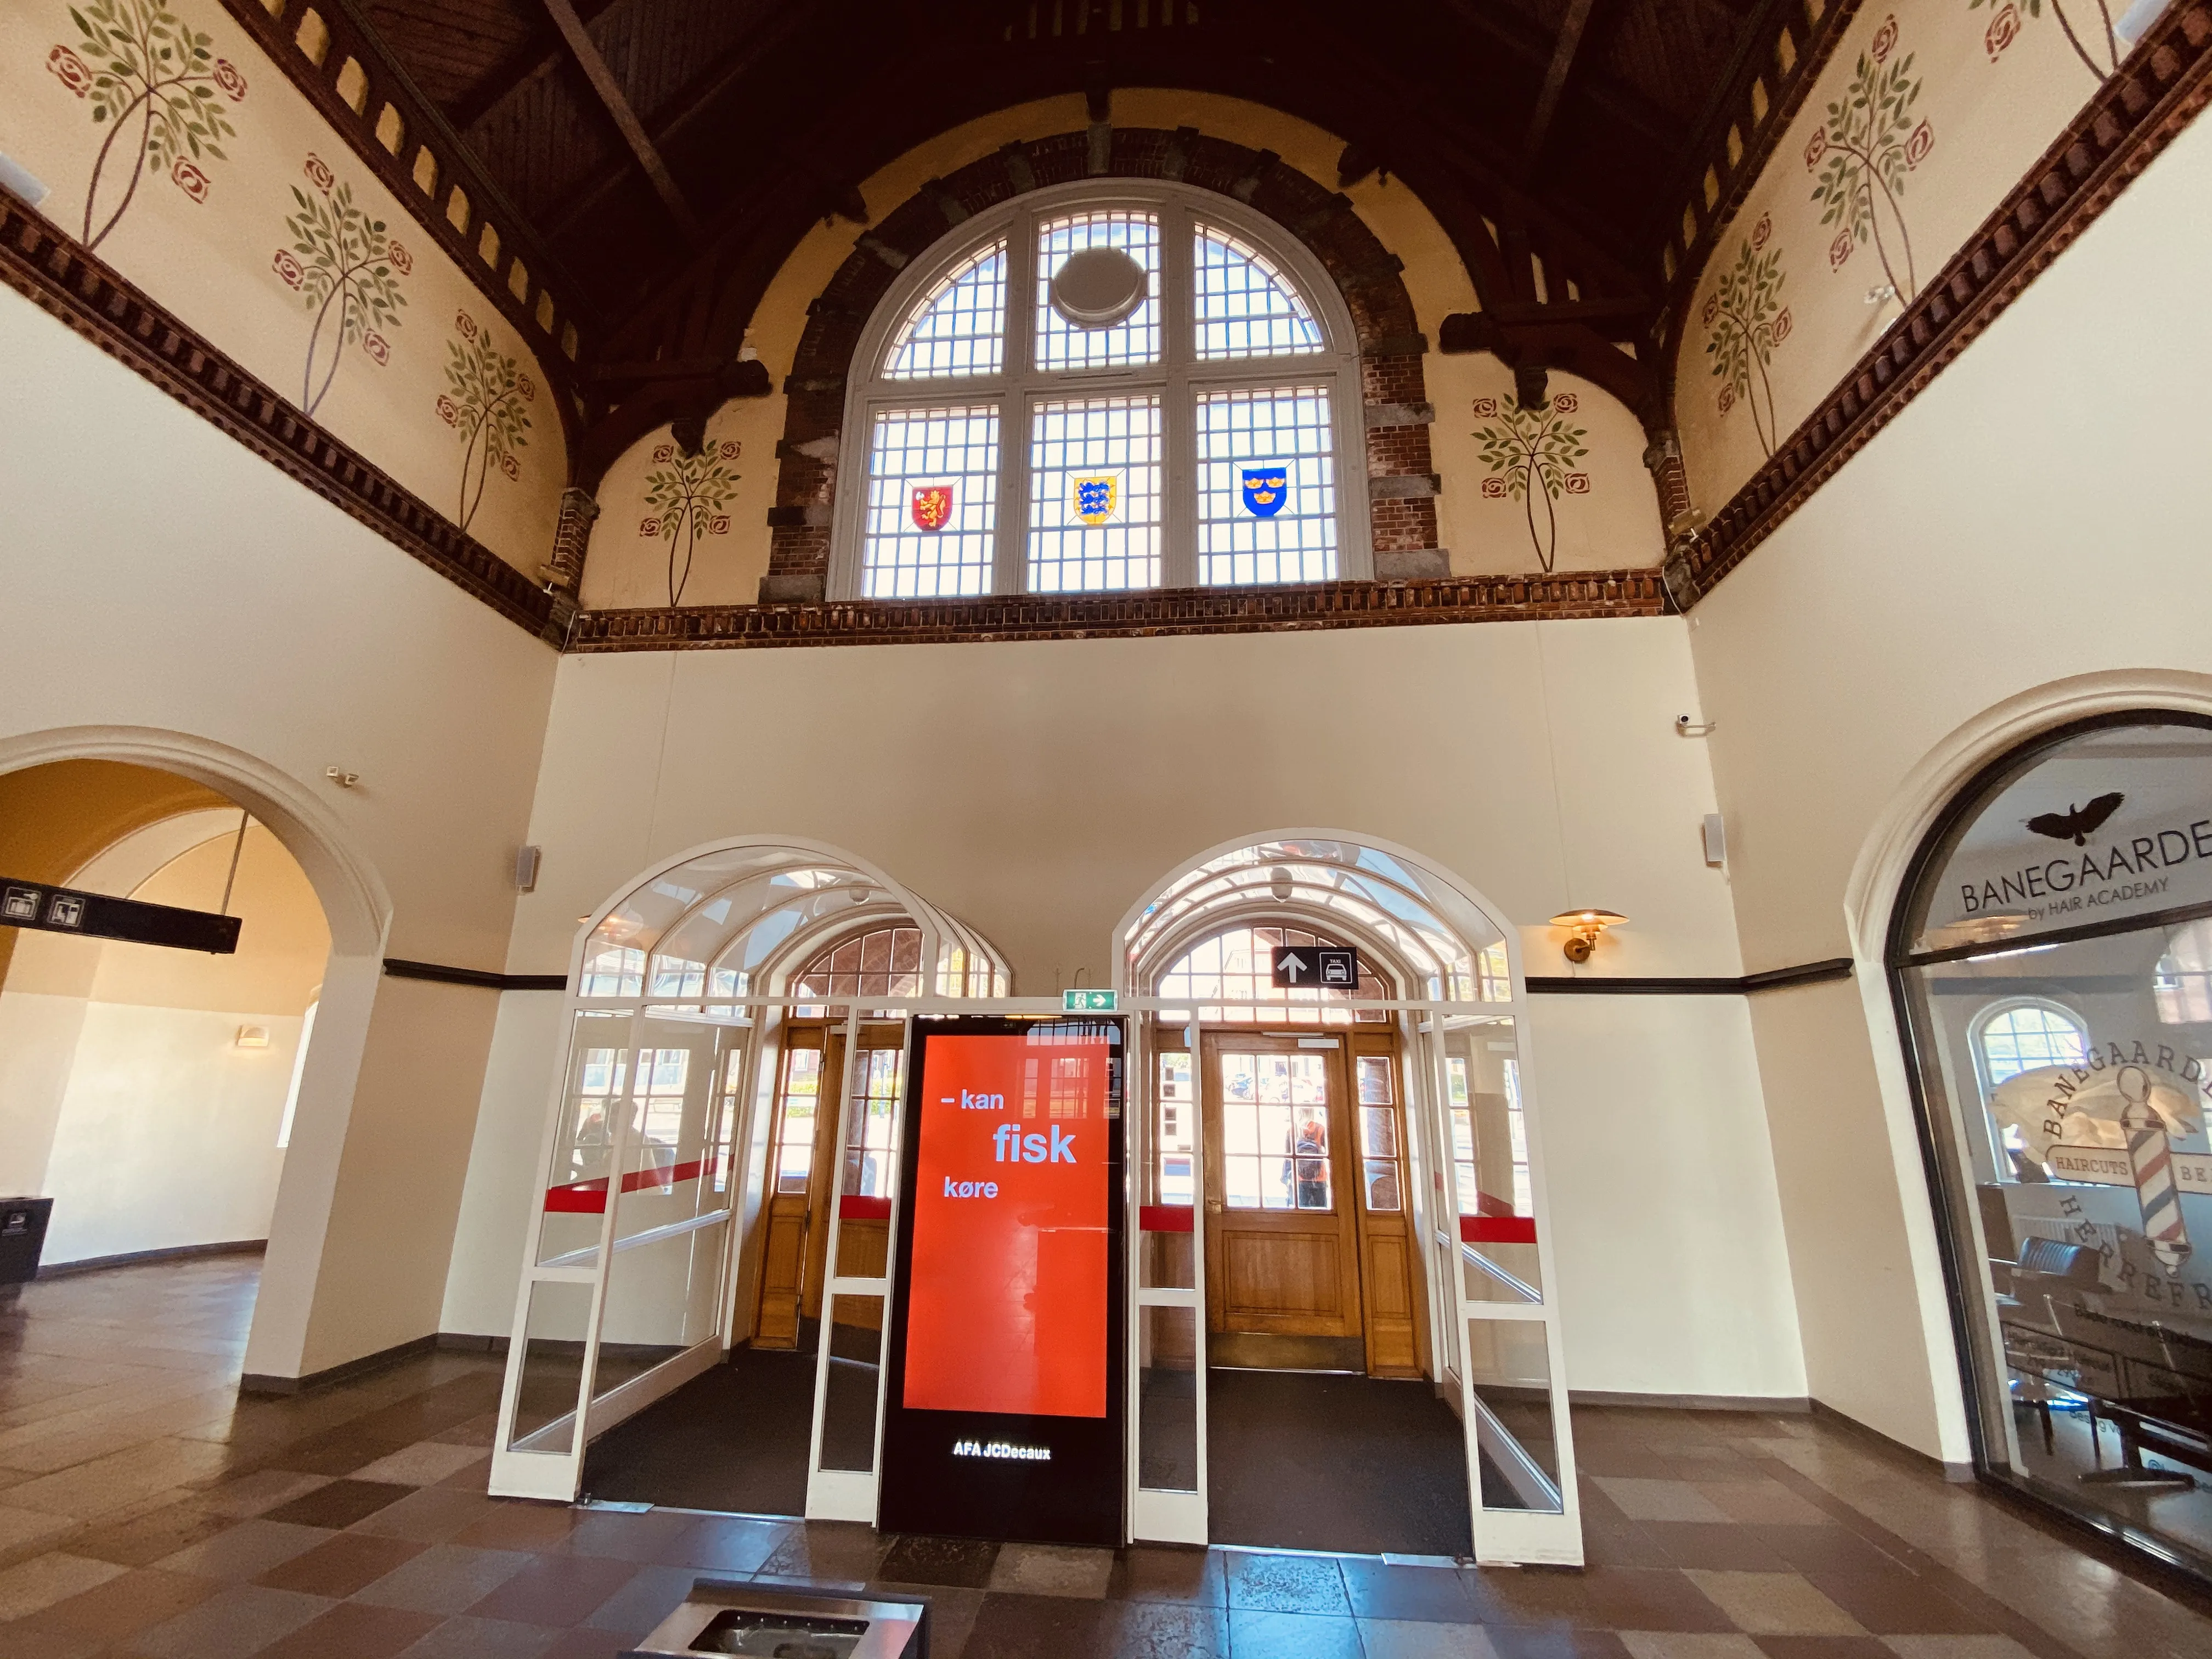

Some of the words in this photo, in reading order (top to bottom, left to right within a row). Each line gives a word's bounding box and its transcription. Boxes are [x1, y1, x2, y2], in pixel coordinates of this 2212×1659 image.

[2029, 906, 2045, 921] by
[2049, 896, 2083, 915] HAIR
[2086, 878, 2169, 907] ACADEMY
[961, 1089, 1005, 1110] kan
[993, 1124, 1077, 1164] fisk
[2055, 1156, 2129, 1176] HAIRCUTS
[944, 1176, 998, 1198] køre
[953, 1441, 981, 1457] AFA
[983, 1443, 1051, 1460] JCDecaux
